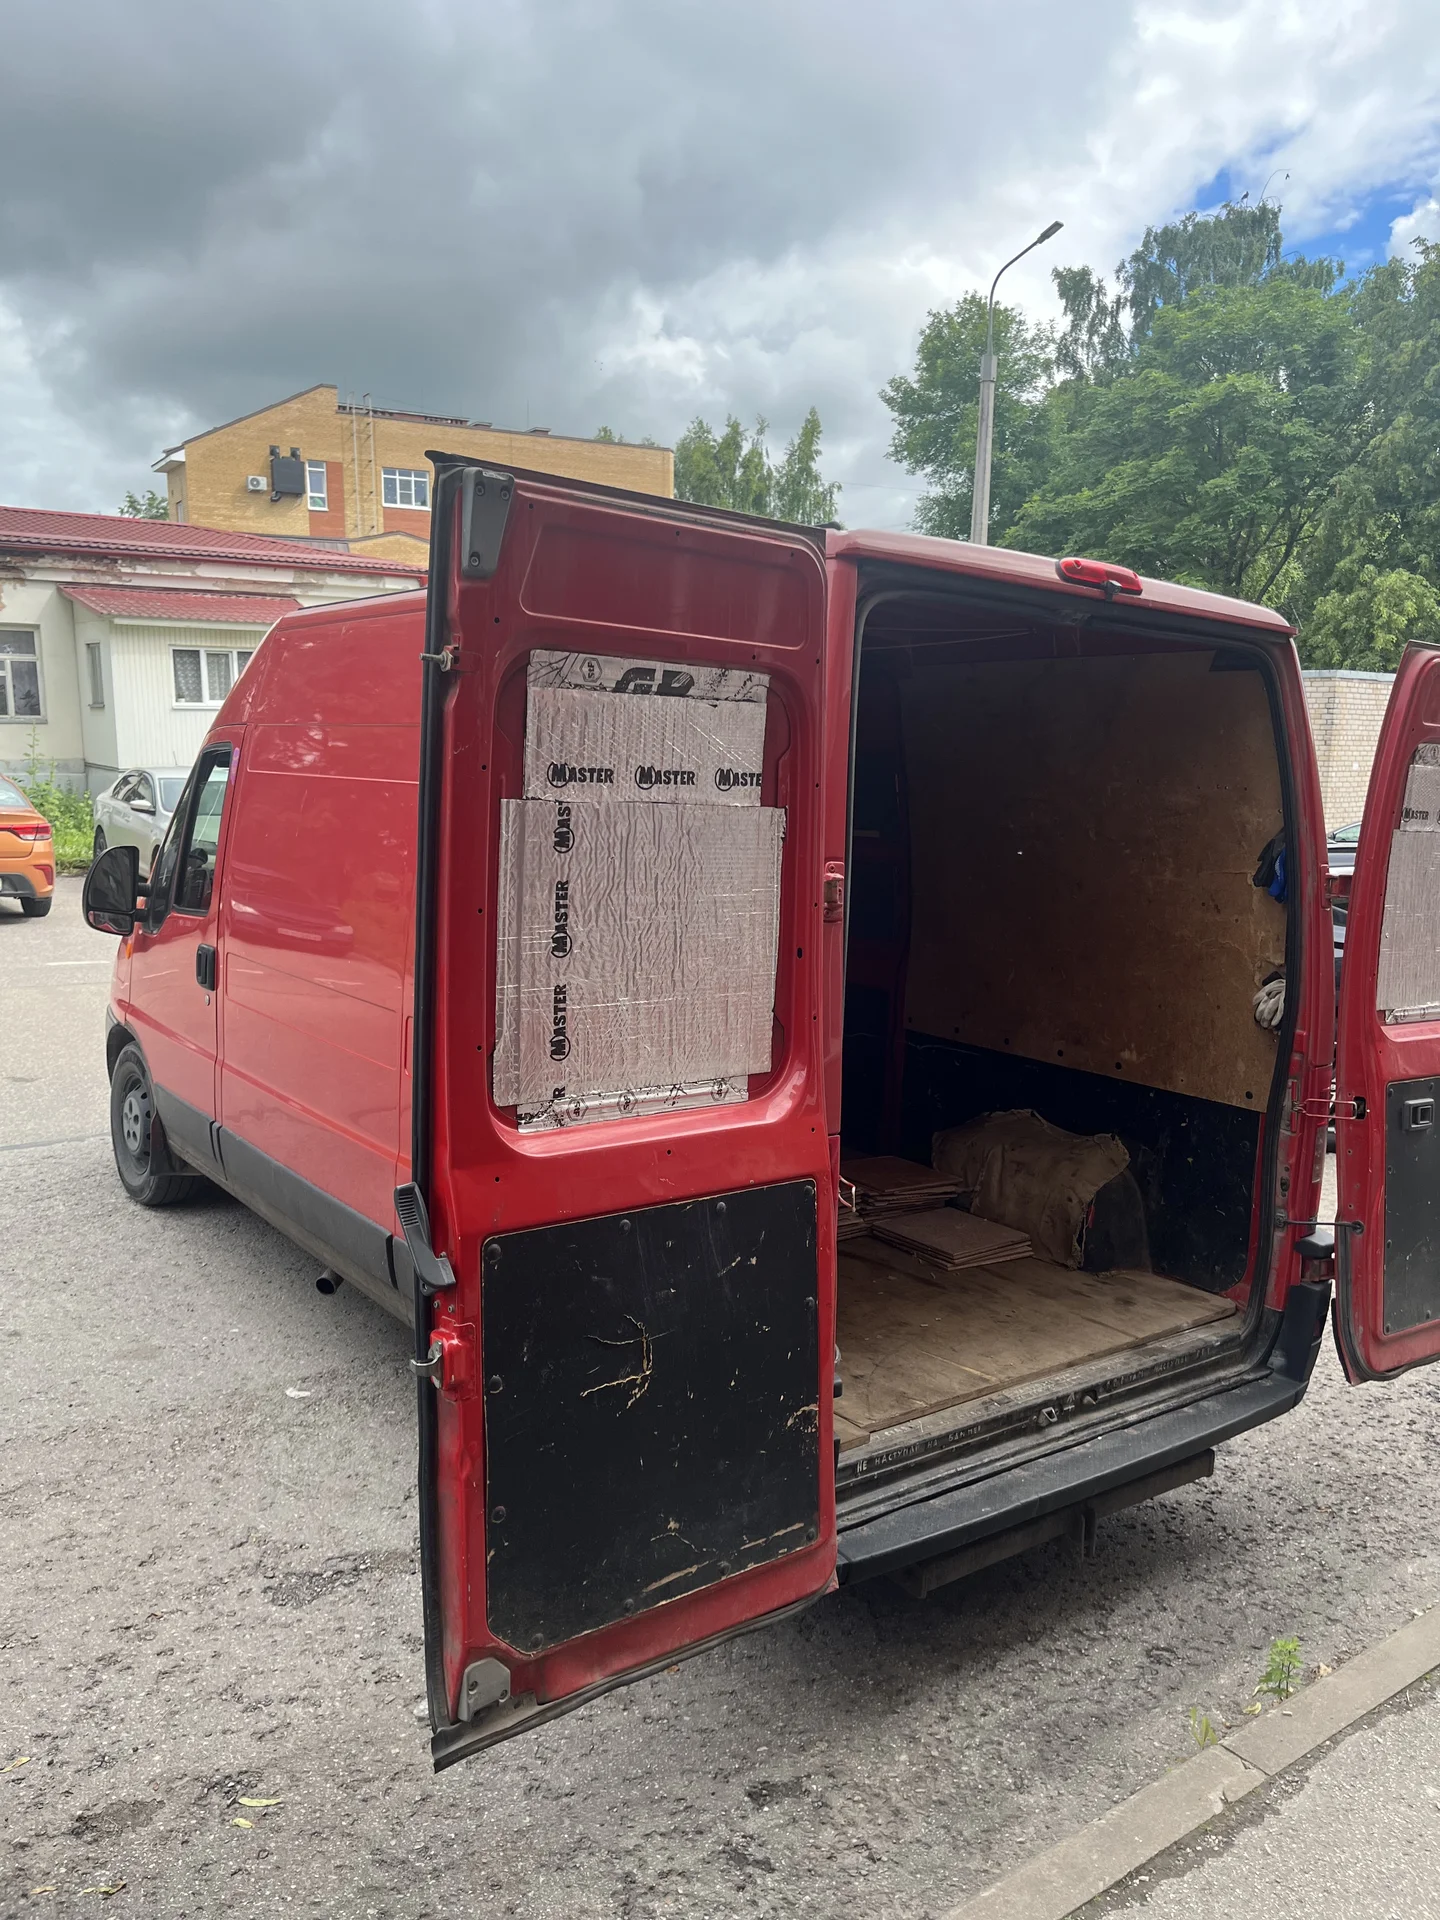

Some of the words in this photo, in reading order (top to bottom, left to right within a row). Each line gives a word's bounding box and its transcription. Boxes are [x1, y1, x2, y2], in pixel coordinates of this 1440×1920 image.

[548, 762, 614, 787] MASTER
[635, 765, 695, 789] MASTER
[553, 800, 575, 853] MAS
[1402, 807, 1429, 822] MASTER
[551, 880, 572, 958] MASTER
[550, 983, 571, 1061] MASTER
[857, 1460, 868, 1473] НЕ
